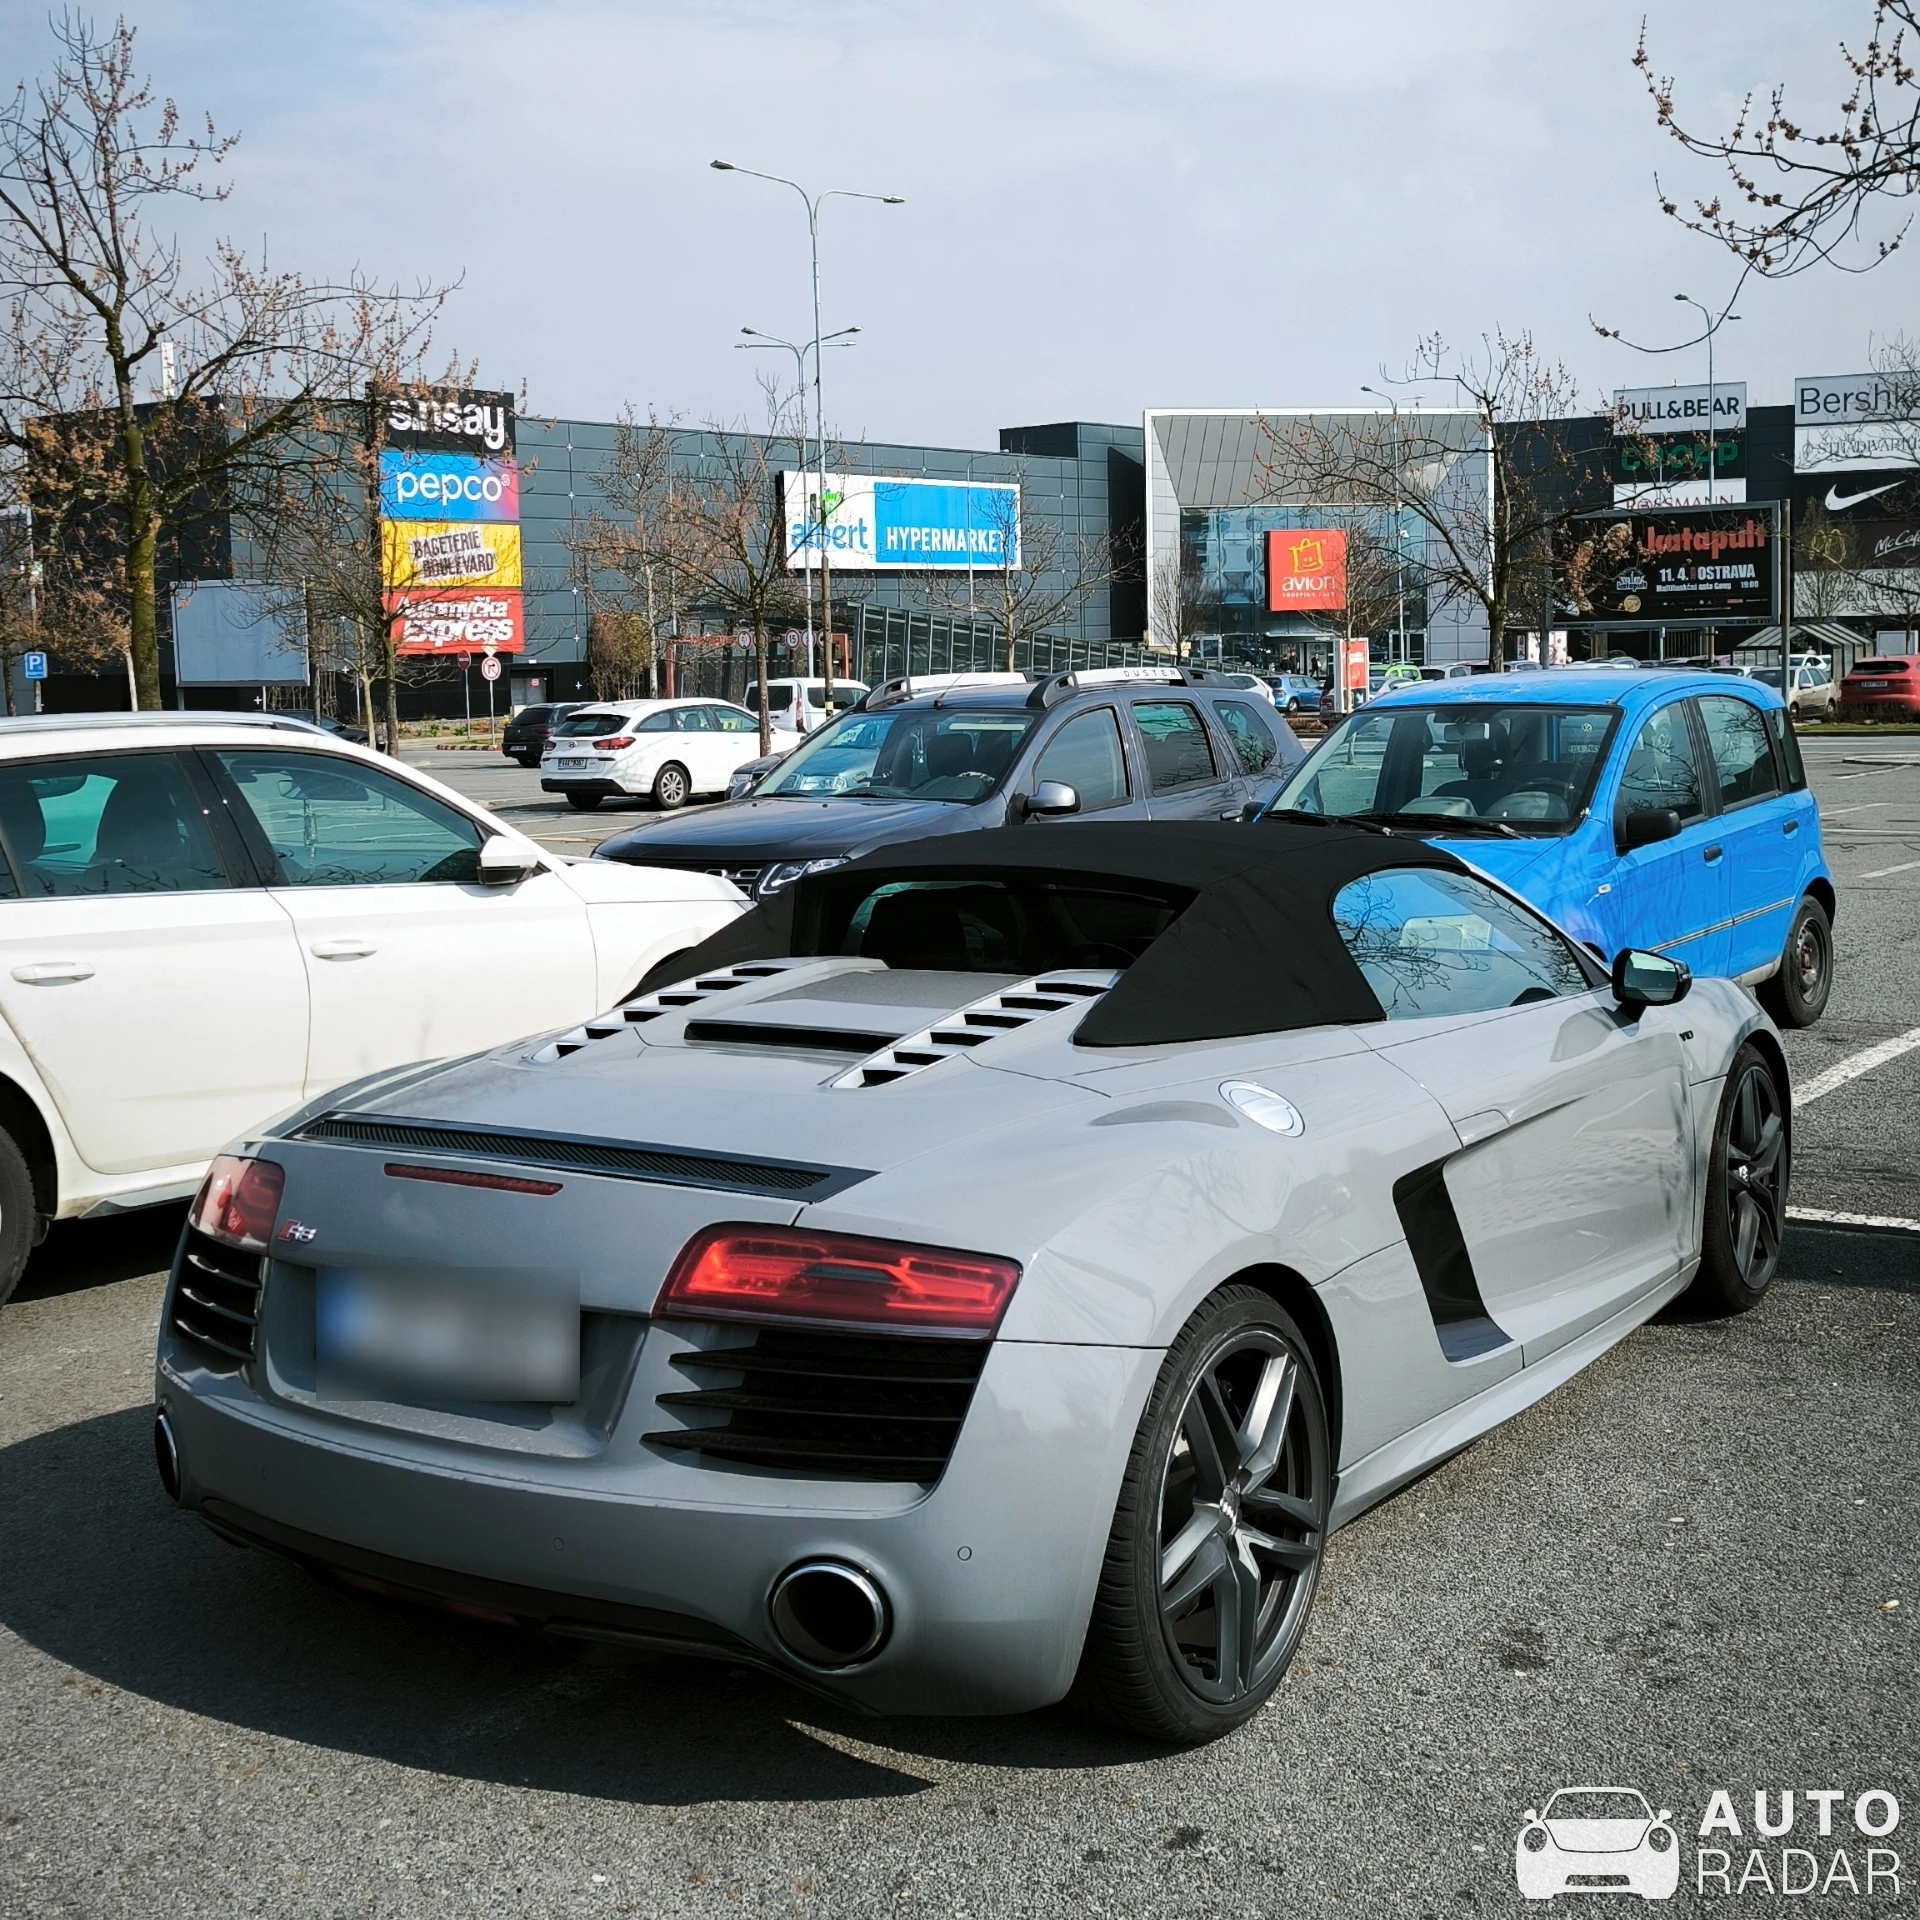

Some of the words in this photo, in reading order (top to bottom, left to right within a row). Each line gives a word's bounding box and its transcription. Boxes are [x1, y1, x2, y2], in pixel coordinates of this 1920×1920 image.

[1621, 397, 1739, 421] PULL&BEAR
[1801, 382, 1920, 415] Bershk
[396, 471, 503, 506] pepco
[412, 530, 481, 560] BAGETERIE
[1647, 519, 1765, 560] katapult
[1875, 530, 1920, 555] McCaf
[422, 552, 495, 578] BOULEVARD
[1659, 568, 1675, 582] 11.
[1677, 567, 1689, 581] 4.
[1697, 563, 1755, 580] OSTRAVA
[788, 634, 797, 647] 15
[28, 655, 42, 671] P
[1123, 669, 1177, 678] DUSTER
